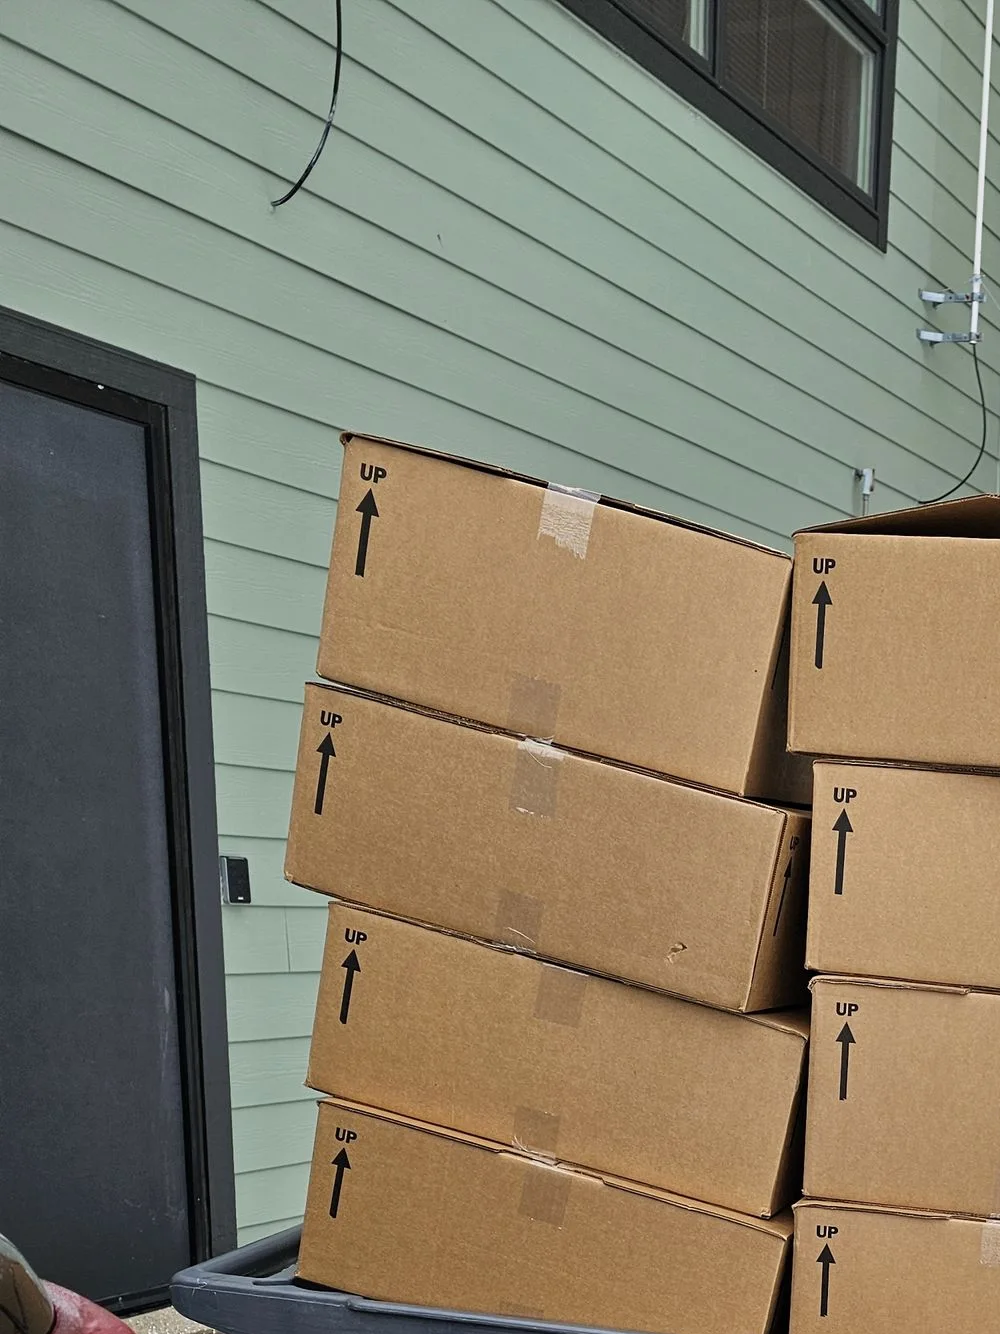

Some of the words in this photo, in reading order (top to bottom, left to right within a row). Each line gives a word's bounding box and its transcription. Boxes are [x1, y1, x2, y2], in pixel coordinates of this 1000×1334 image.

[359, 462, 387, 484] UP
[812, 557, 836, 575] UP
[320, 709, 343, 729] UP
[833, 787, 858, 804] UP
[344, 927, 368, 946] UP
[835, 1001, 859, 1017] UP
[334, 1126, 358, 1144] UP
[816, 1224, 839, 1239] UP
